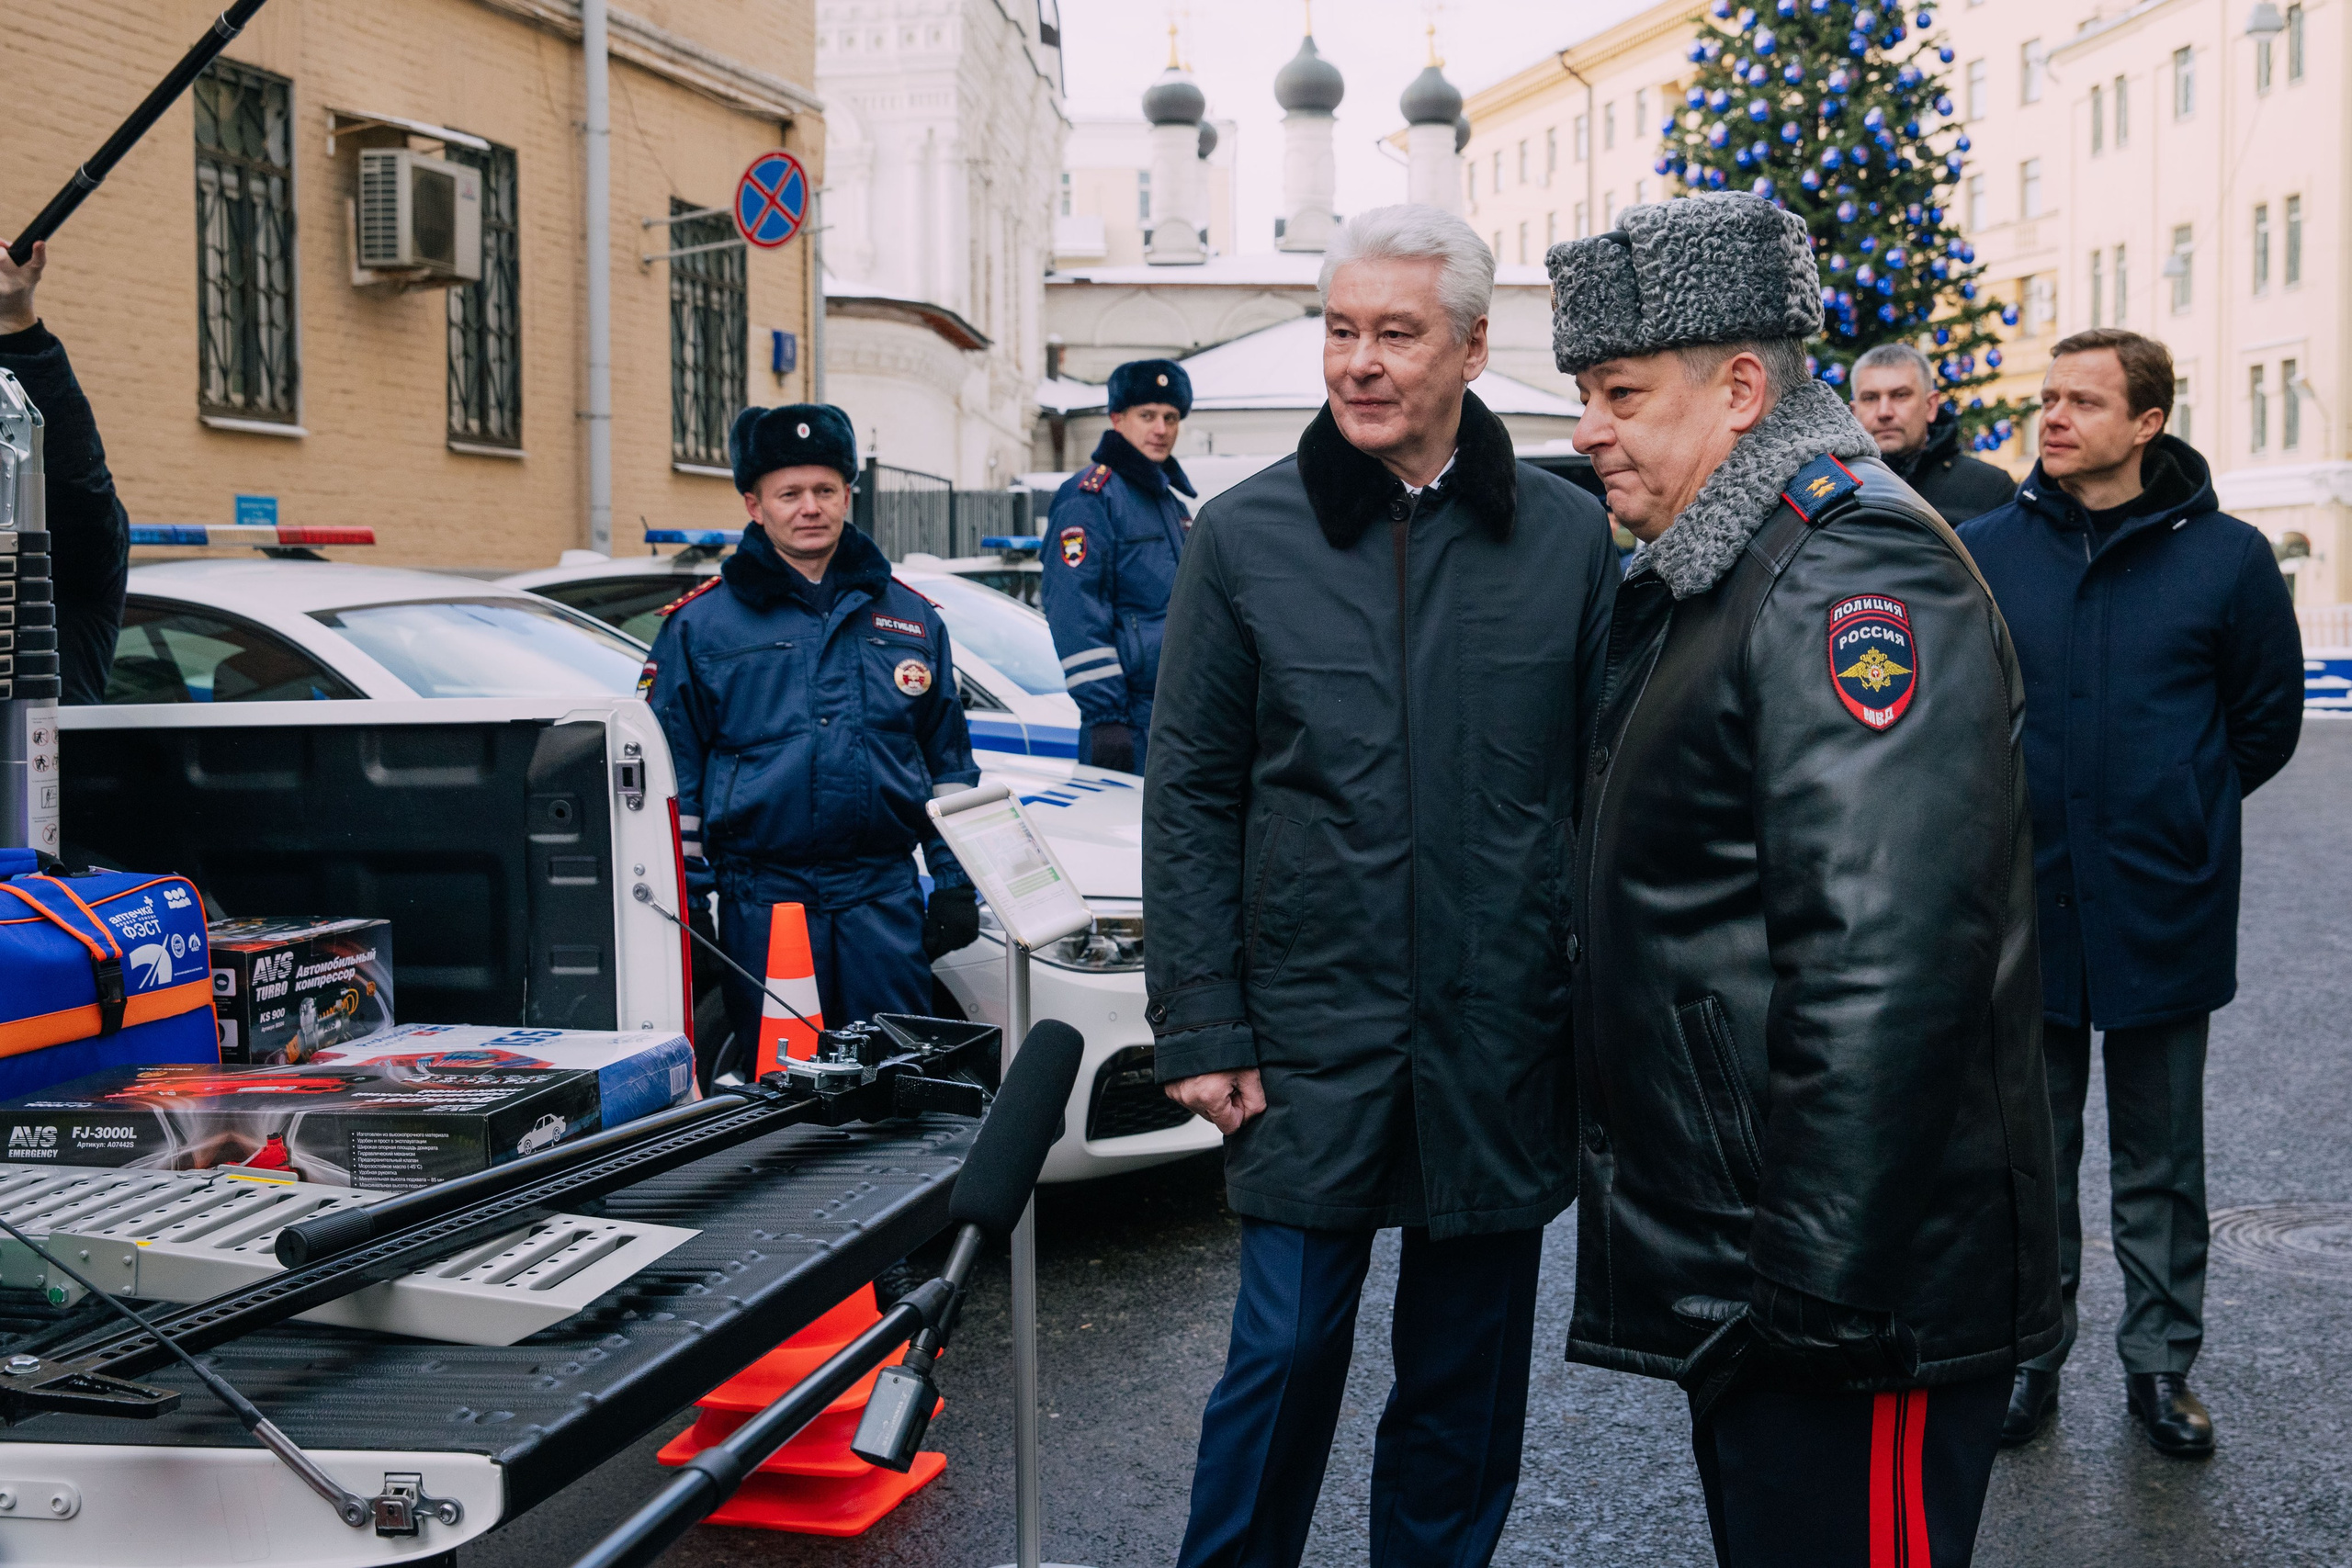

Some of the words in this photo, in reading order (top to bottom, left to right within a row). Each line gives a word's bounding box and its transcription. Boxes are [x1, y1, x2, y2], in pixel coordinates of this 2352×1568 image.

[1834, 598, 1904, 622] ПОЛИЦИЯ
[875, 616, 894, 628] ДПС
[894, 620, 922, 635] ГИБДД
[1838, 626, 1905, 650] РОССИЯ
[1863, 706, 1894, 727] МВД
[108, 906, 154, 924] аптечка
[122, 919, 162, 940] ФЭСТ
[252, 951, 295, 986] AVS
[295, 947, 377, 979] Автомобильный
[295, 967, 356, 992] компрессор
[255, 981, 288, 1002] TURBO
[259, 1011, 271, 1023] KS
[271, 1007, 286, 1021] 900
[479, 1030, 563, 1046] 155
[8, 1125, 58, 1148] AVS
[72, 1126, 137, 1139] FJ-3000L
[8, 1149, 59, 1158] EMERGENCY
[76, 1141, 106, 1149] Артикул:
